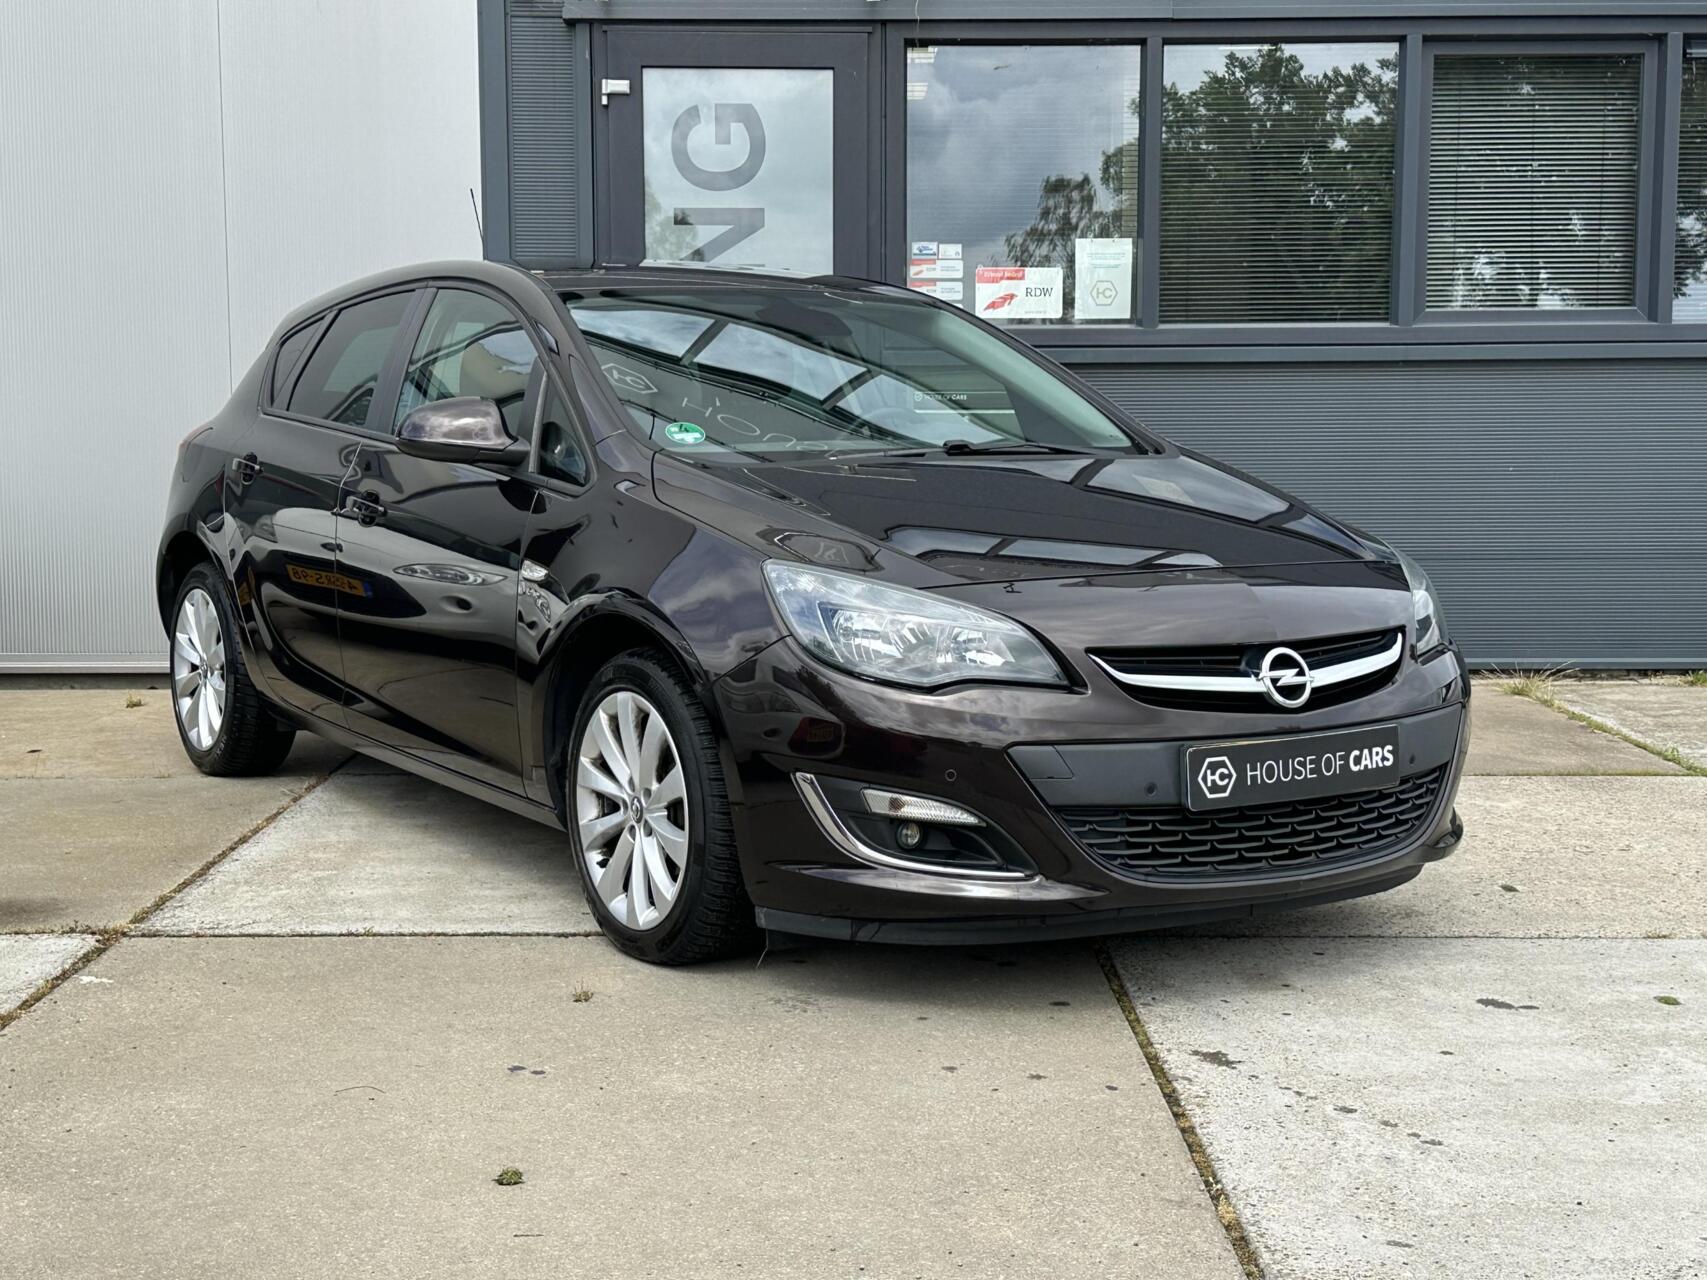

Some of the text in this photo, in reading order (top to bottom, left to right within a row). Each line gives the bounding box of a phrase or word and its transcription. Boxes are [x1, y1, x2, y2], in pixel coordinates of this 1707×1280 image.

[1025, 287, 1053, 297] RDW
[1247, 755, 1317, 786] HOUSE
[1321, 752, 1346, 777] OF
[1349, 745, 1394, 772] CARS
